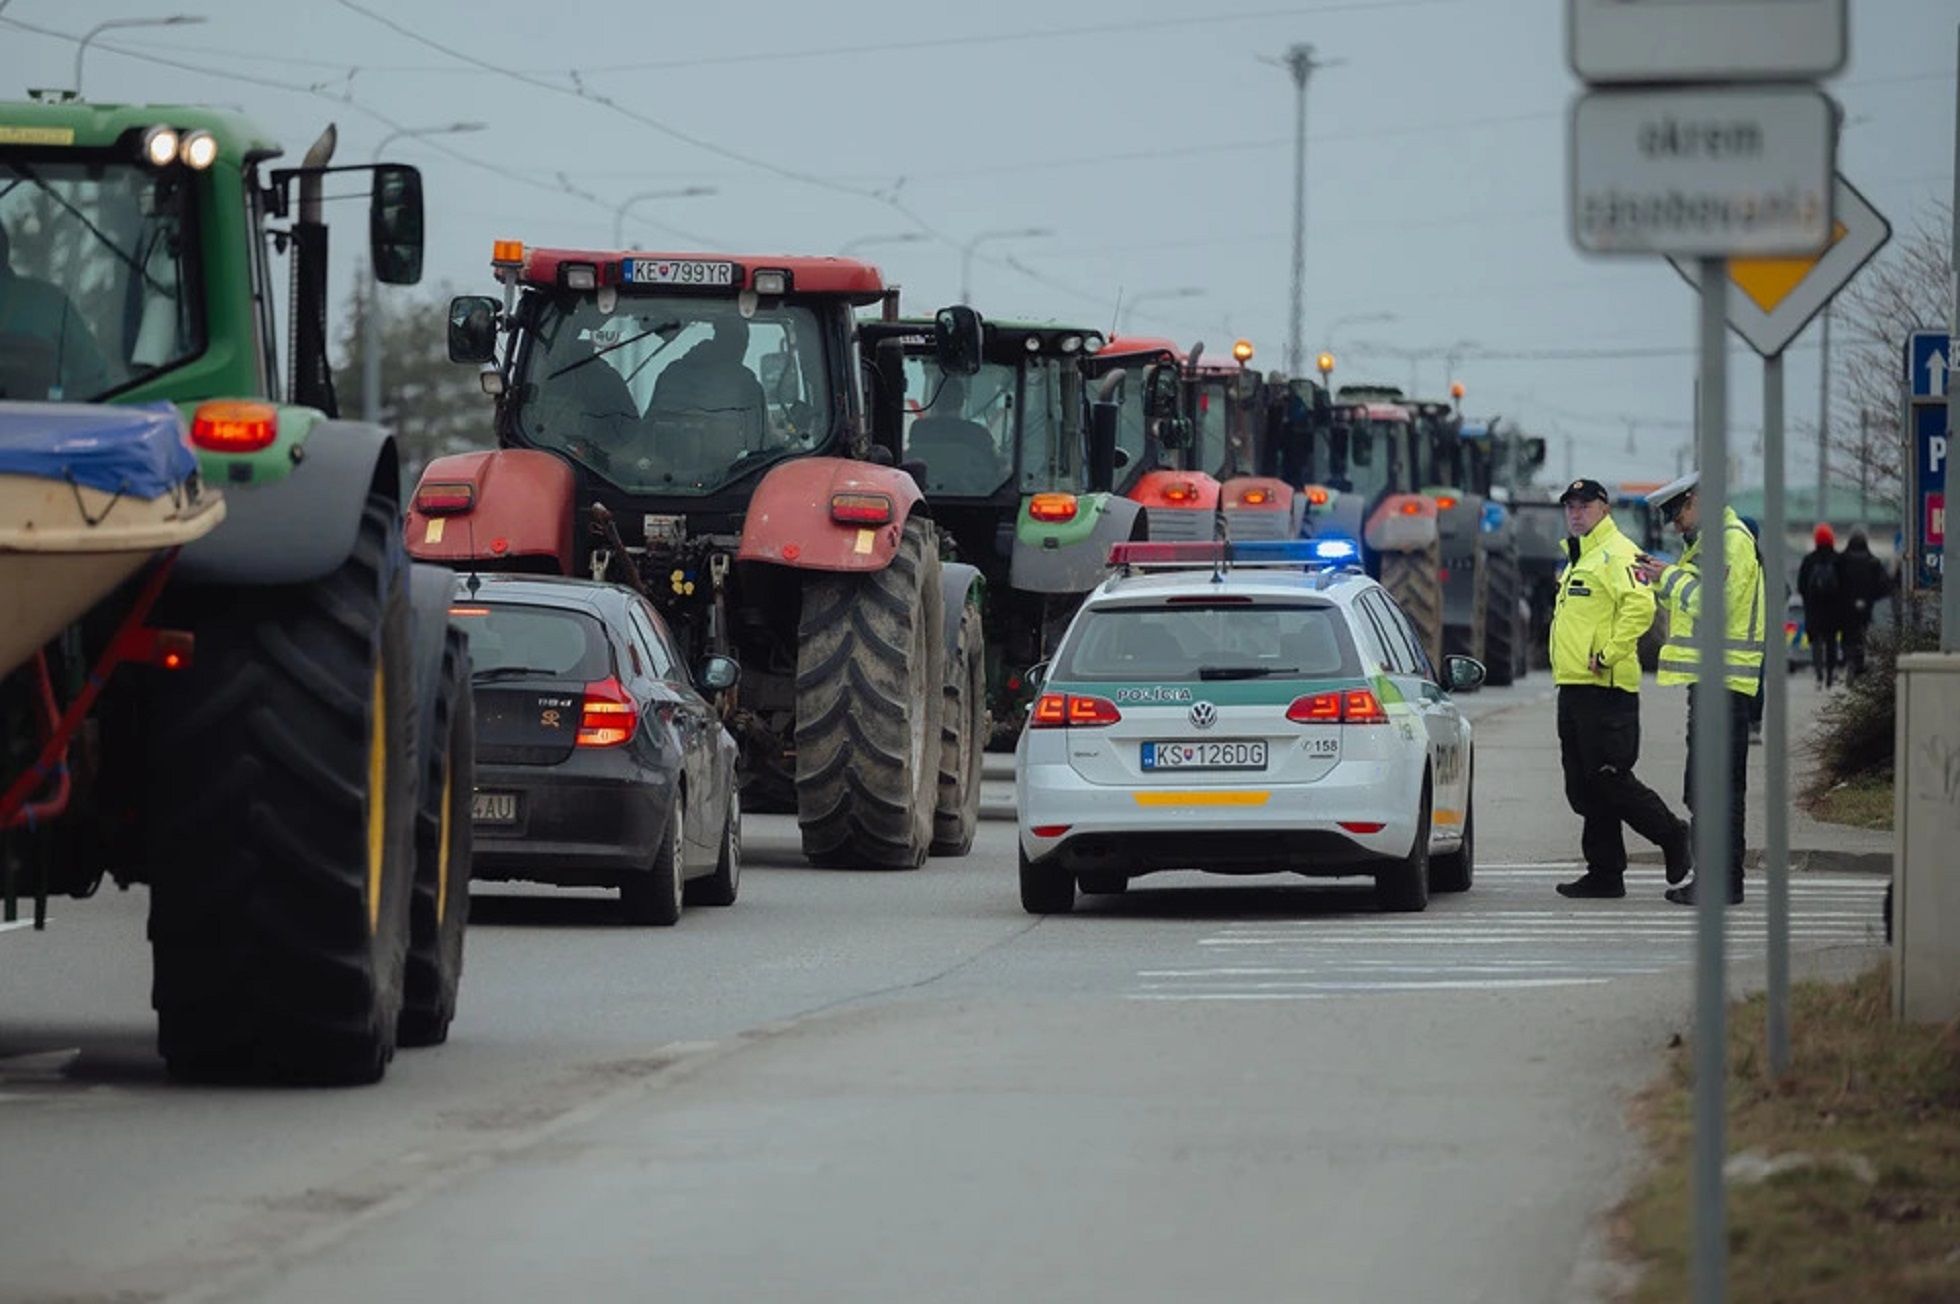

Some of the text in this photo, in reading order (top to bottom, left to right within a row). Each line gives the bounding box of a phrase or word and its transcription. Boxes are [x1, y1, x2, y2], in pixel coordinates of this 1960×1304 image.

[635, 262, 730, 283] KE 799YR
[1117, 685, 1192, 701] POLÍCIA
[1157, 744, 1263, 765] KS 126DG
[1315, 740, 1338, 752] 158
